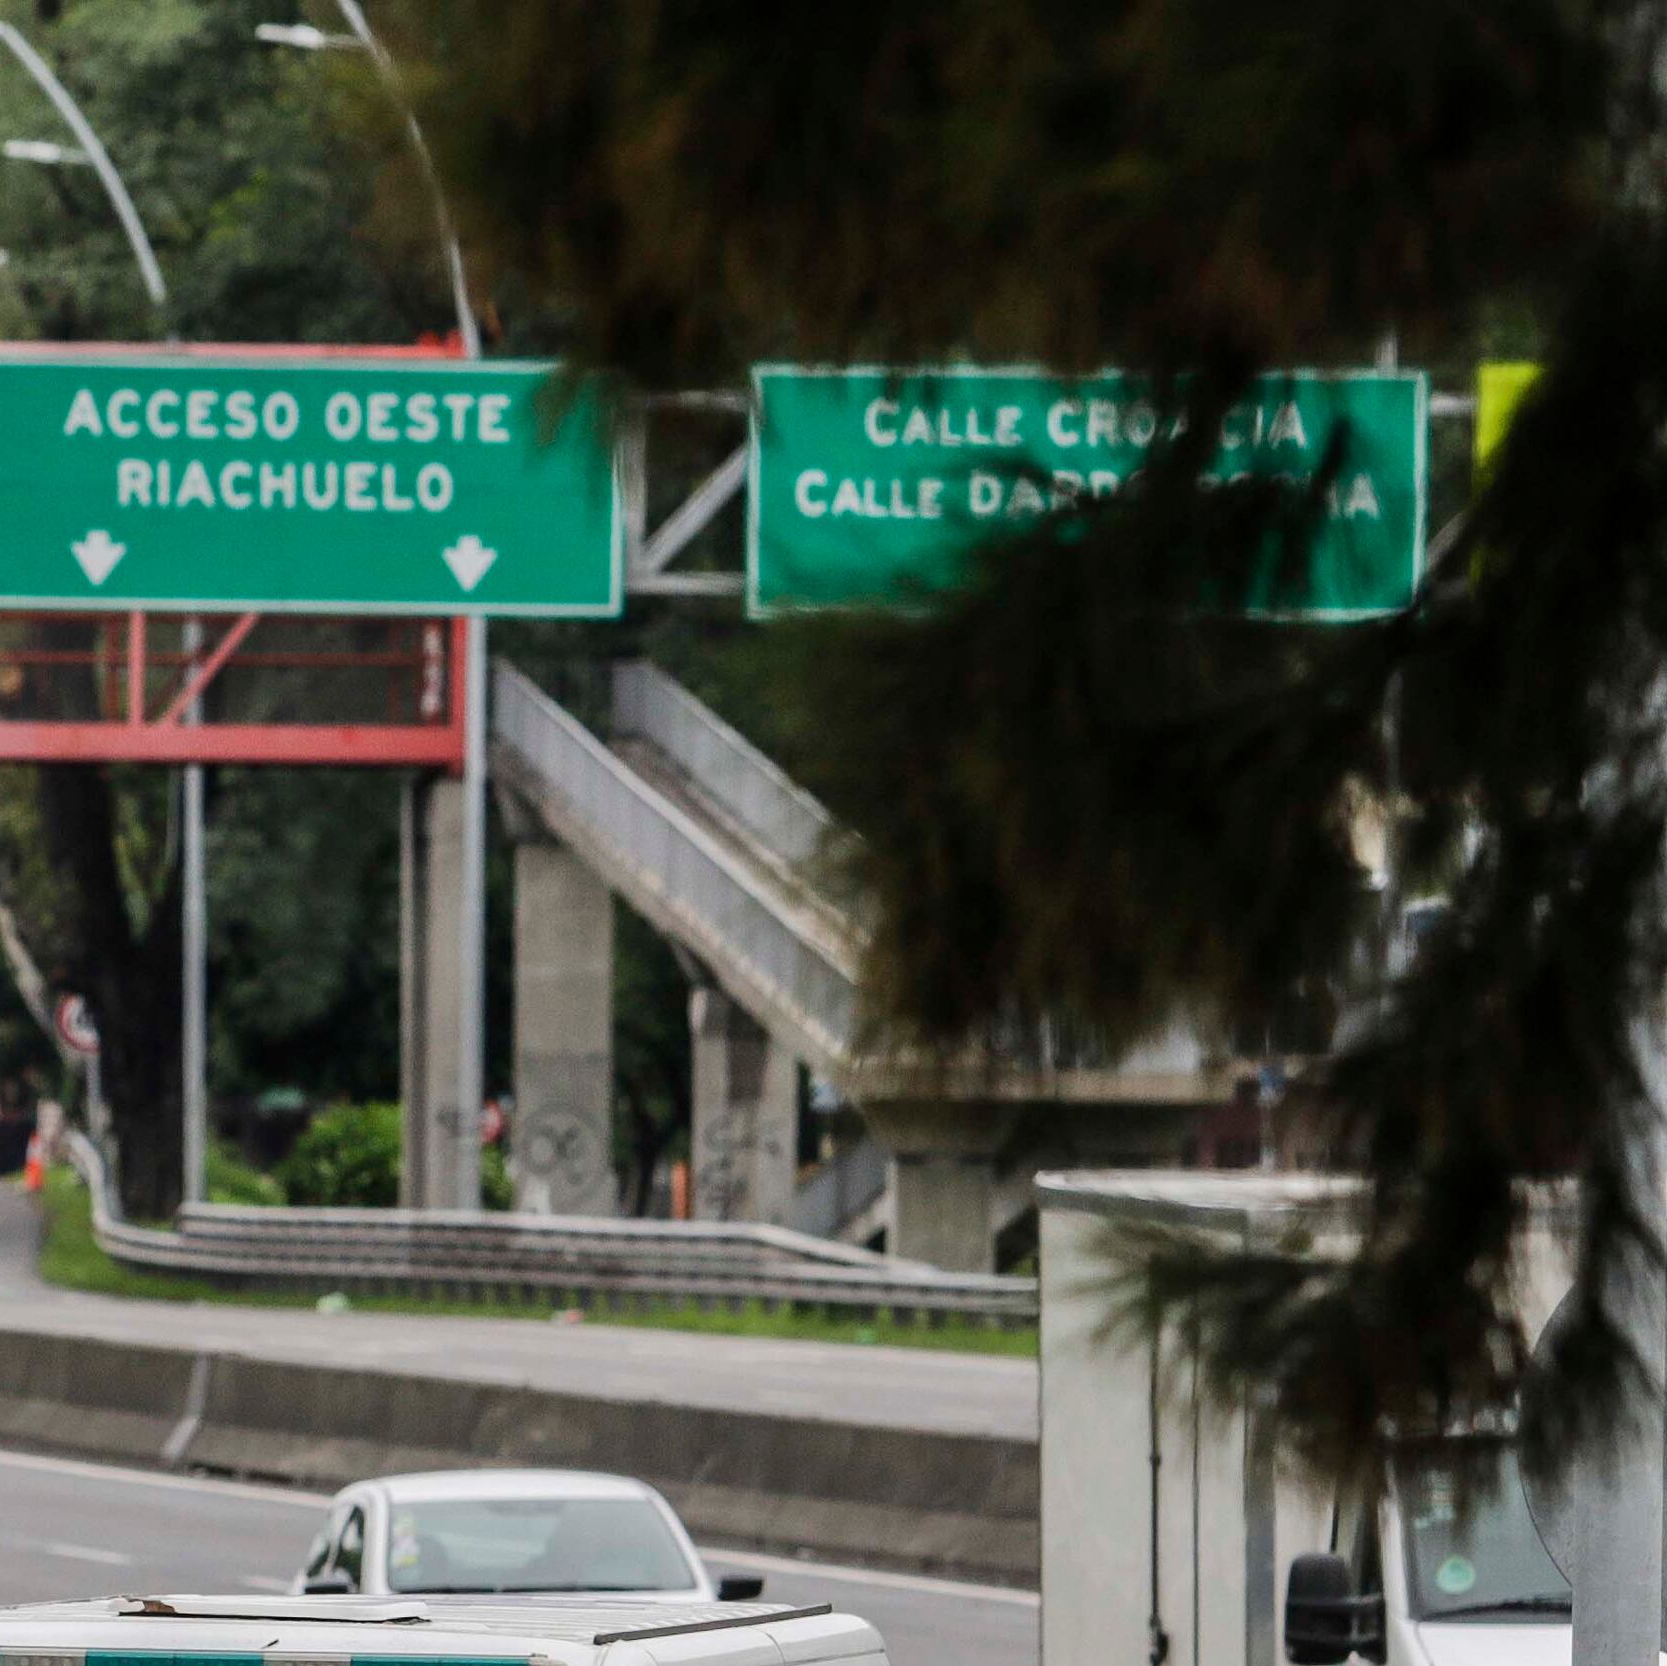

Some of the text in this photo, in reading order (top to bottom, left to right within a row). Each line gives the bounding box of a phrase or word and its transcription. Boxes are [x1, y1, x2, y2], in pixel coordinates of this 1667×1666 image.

[64, 389, 512, 444] ACCESO OESTE
[865, 398, 1023, 448] CALLE
[116, 458, 455, 512] RIACHUELO
[794, 470, 944, 520] CALLE
